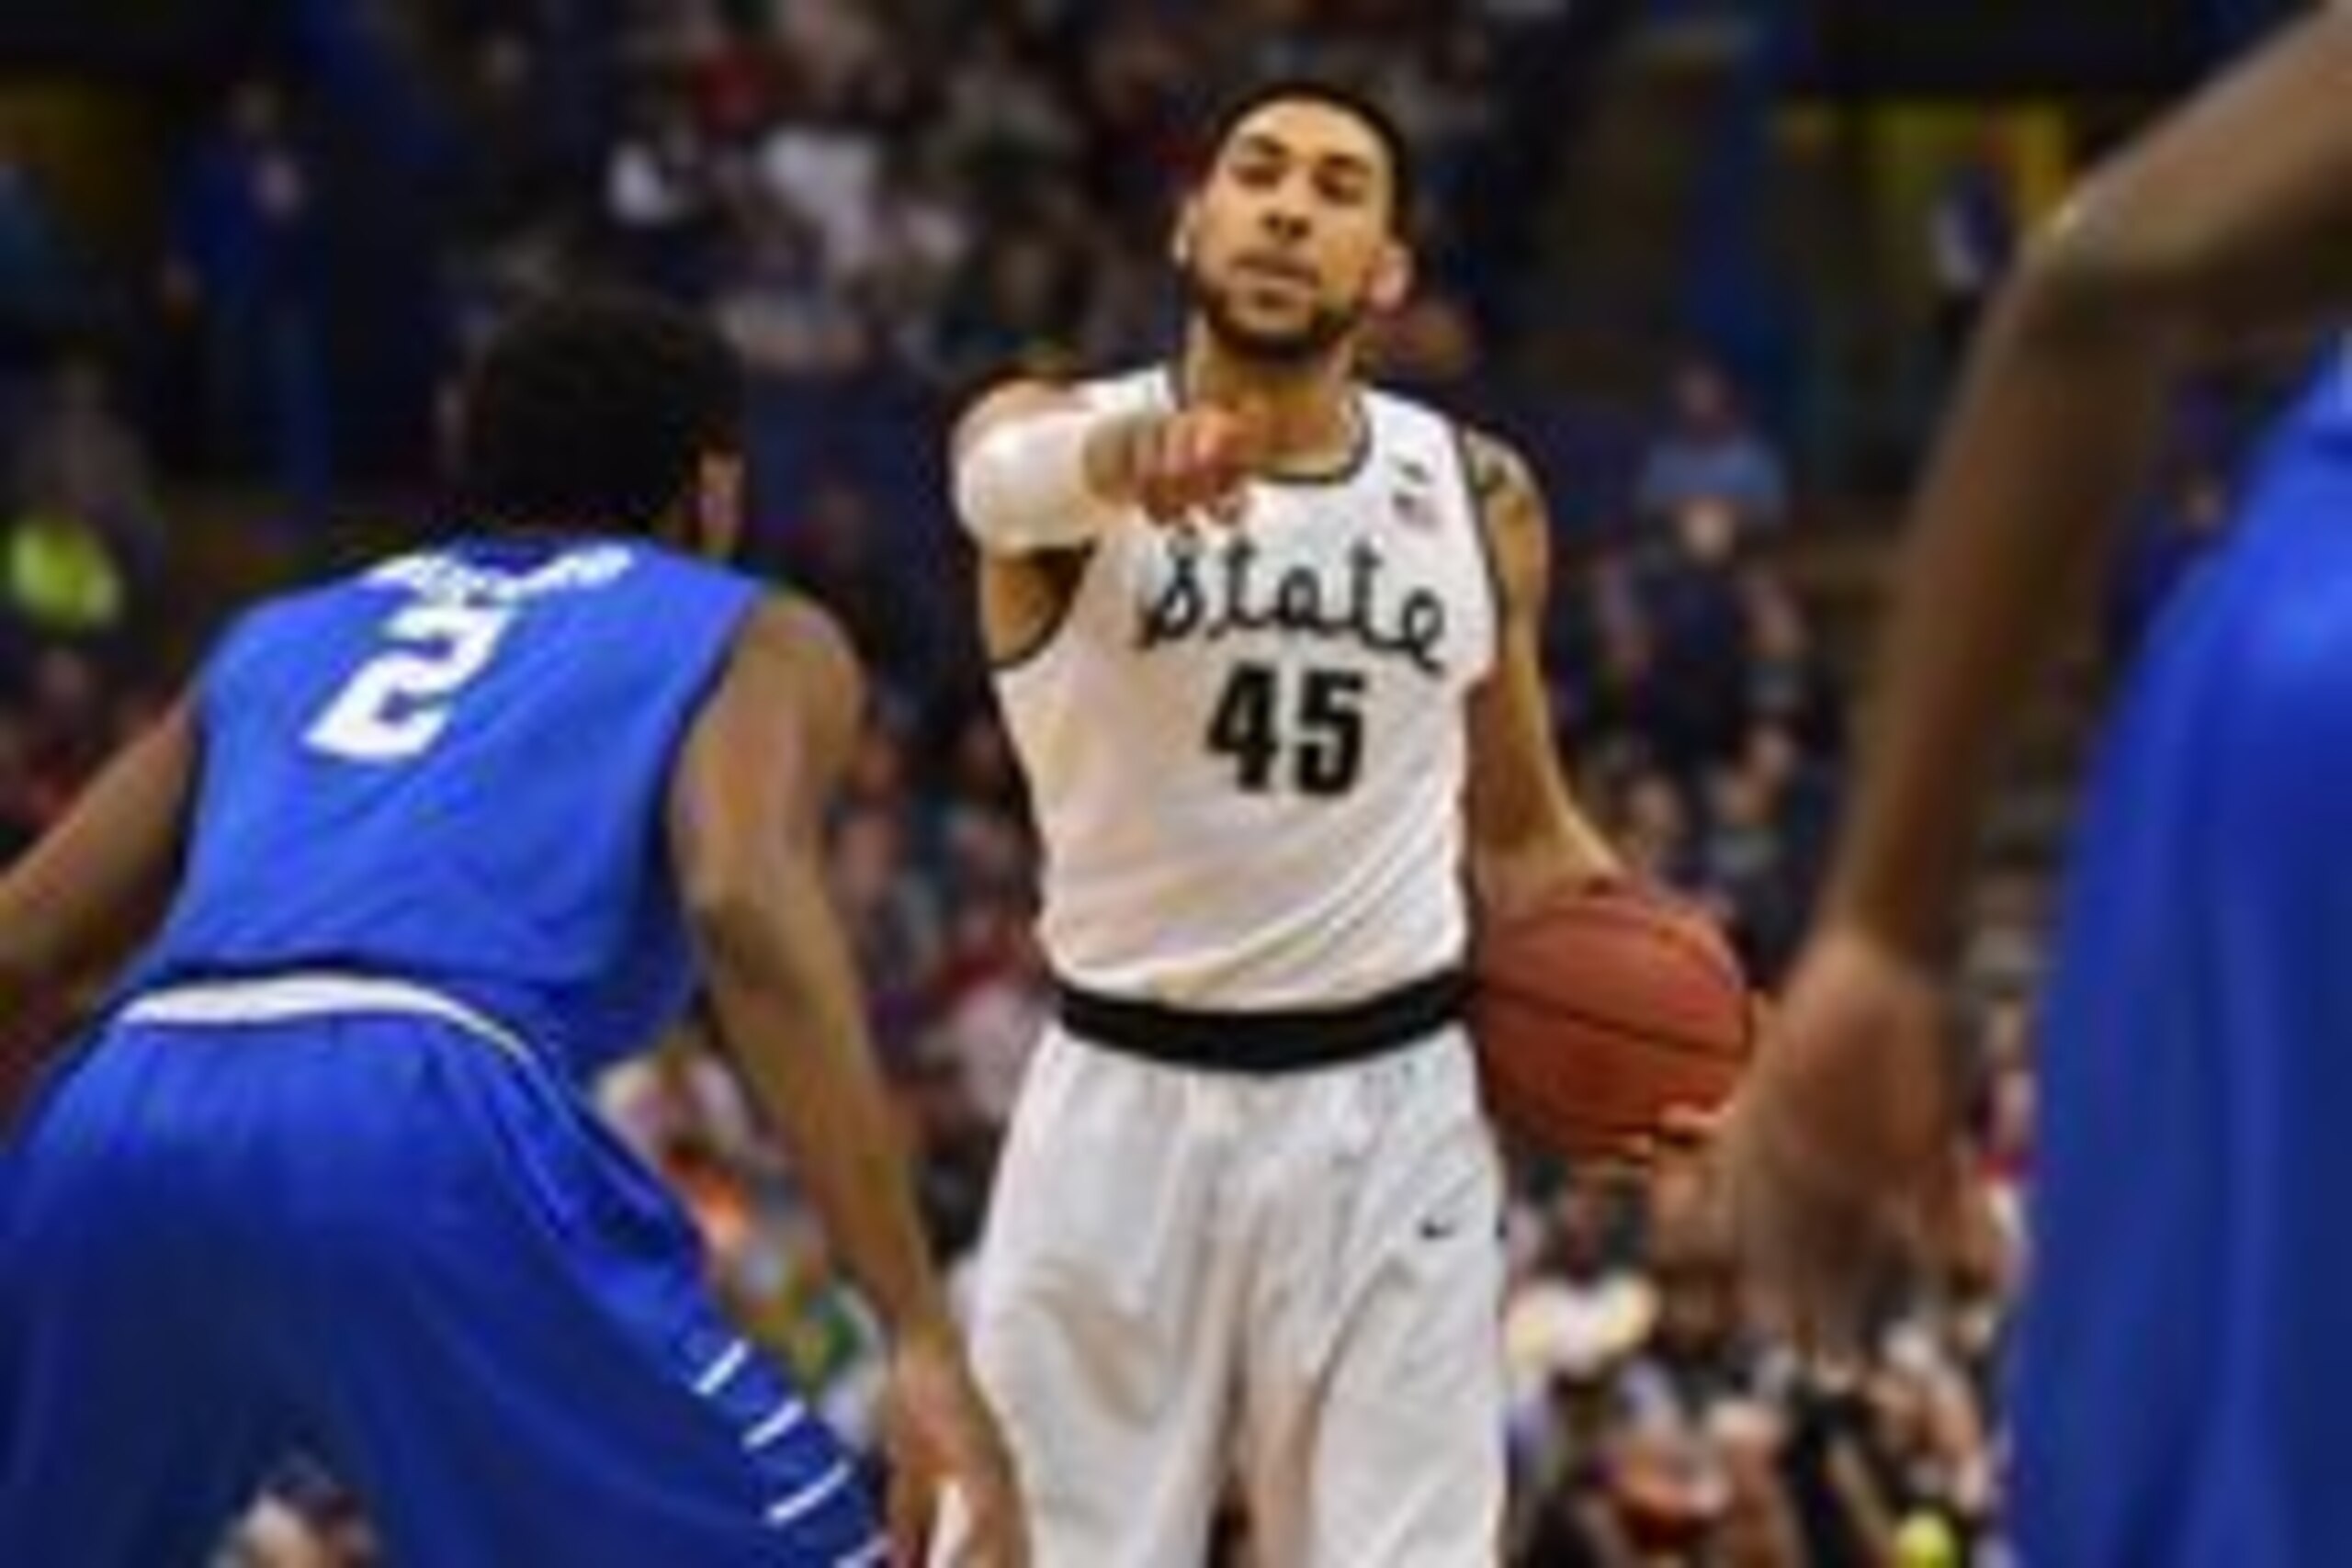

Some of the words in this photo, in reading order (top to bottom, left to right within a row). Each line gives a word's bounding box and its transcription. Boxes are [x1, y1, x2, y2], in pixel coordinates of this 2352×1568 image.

[1137, 527, 1447, 678] State
[303, 604, 511, 757] 2
[1207, 660, 1365, 795] 45
